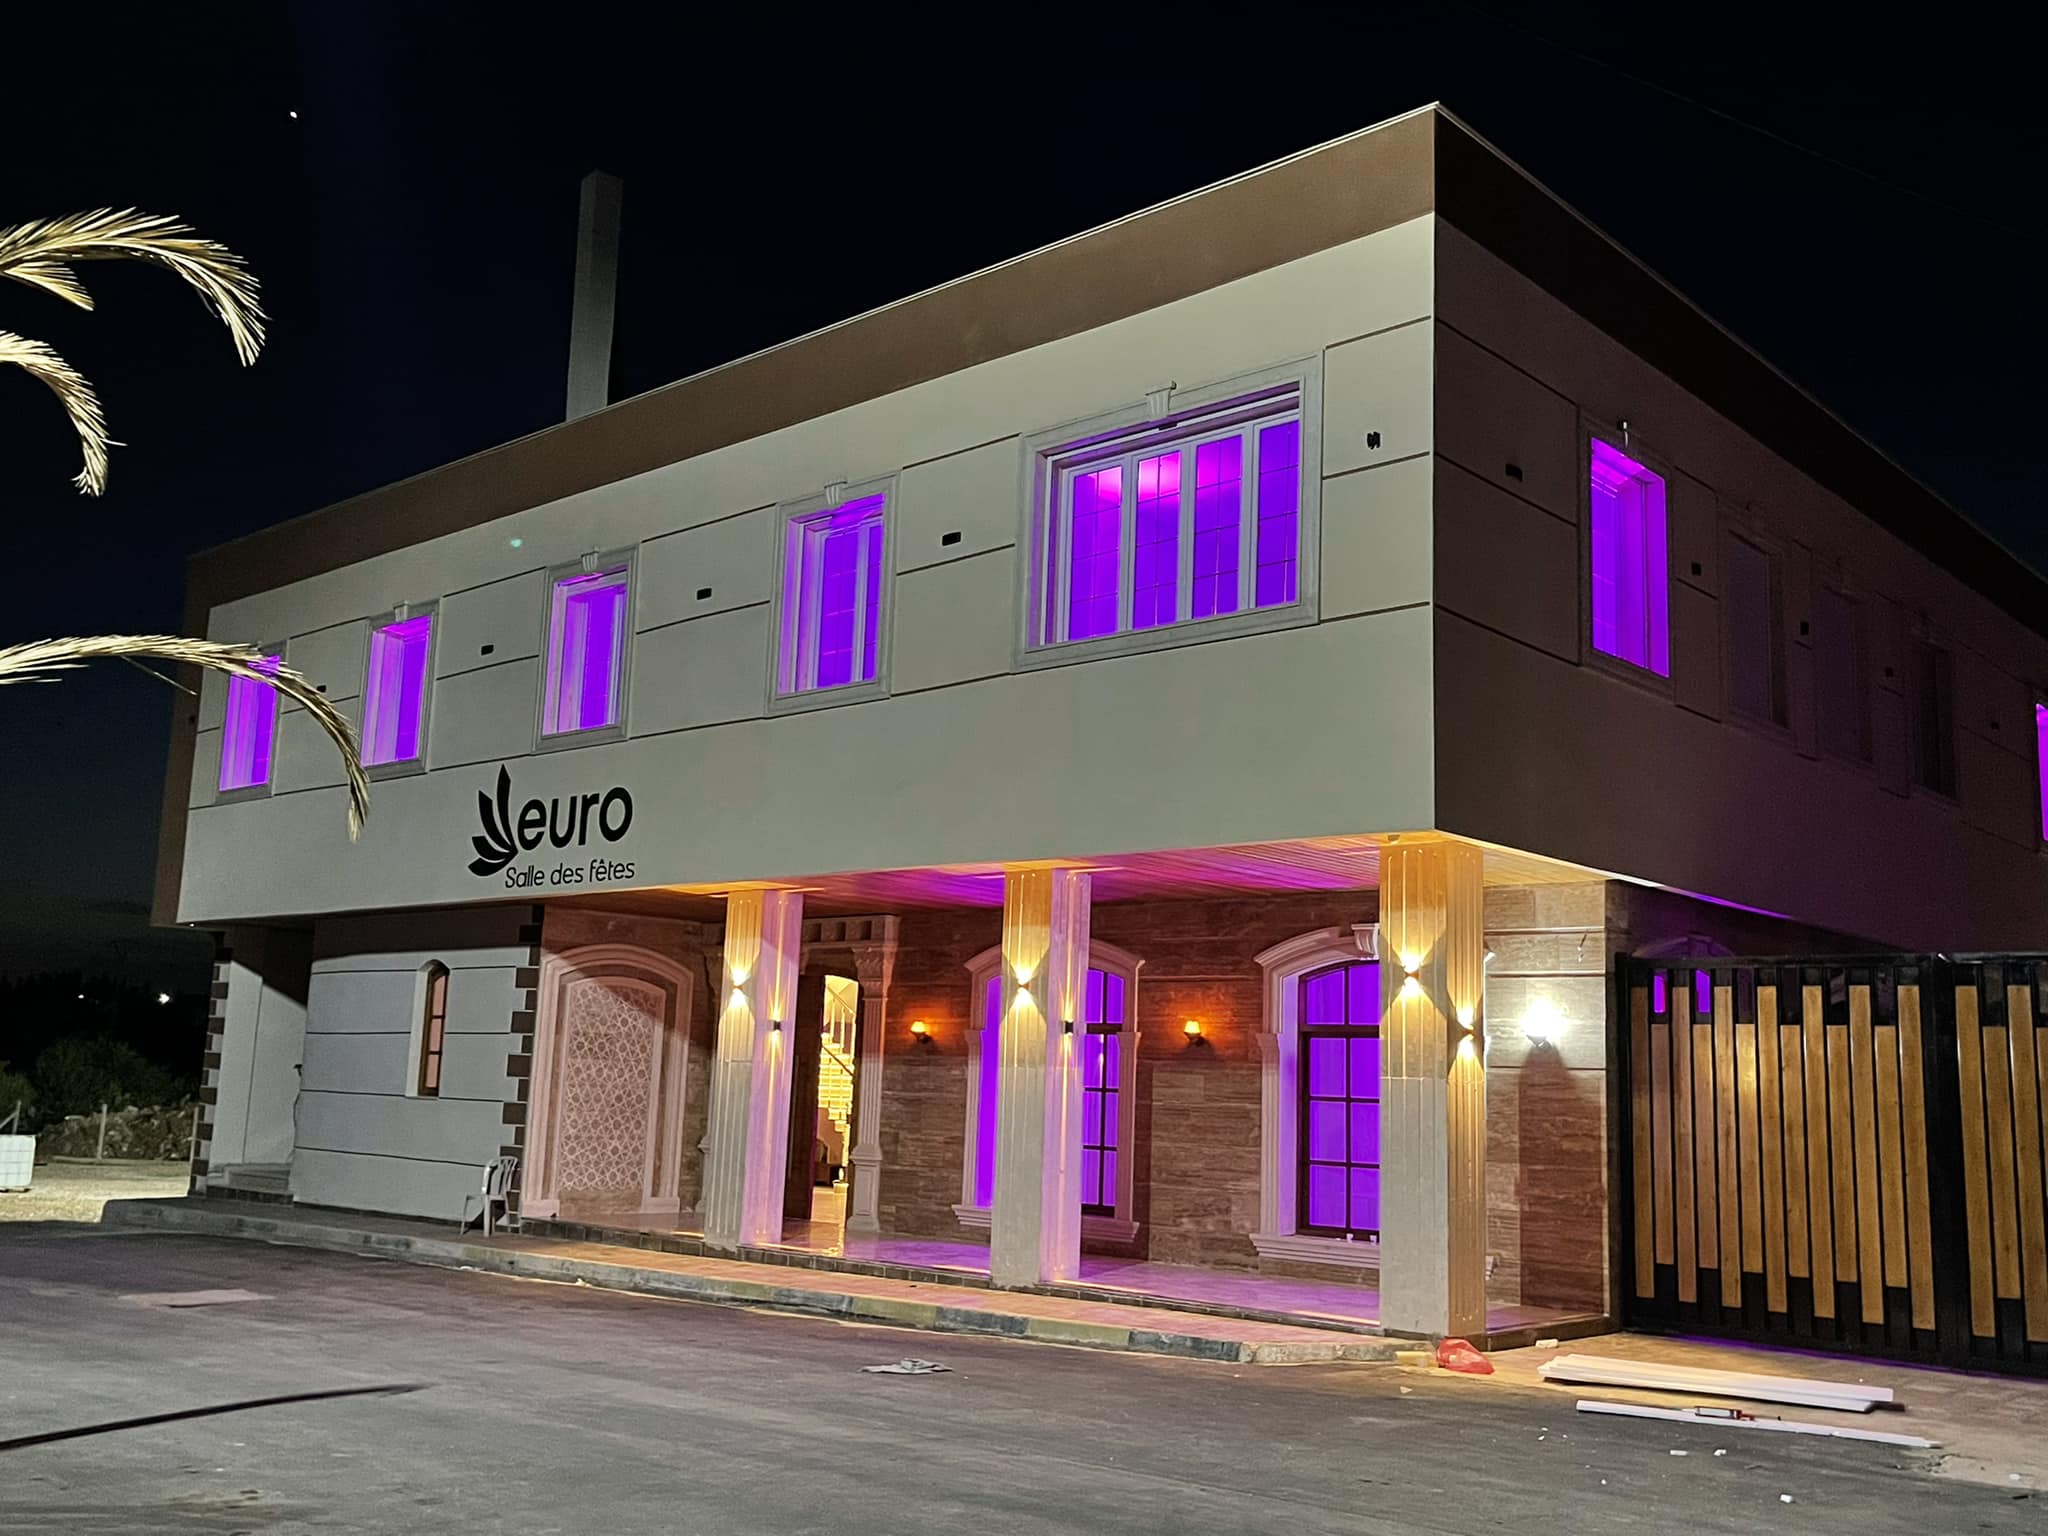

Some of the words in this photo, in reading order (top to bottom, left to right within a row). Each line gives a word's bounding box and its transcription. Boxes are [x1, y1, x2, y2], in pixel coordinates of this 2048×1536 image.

[505, 865, 545, 888] Salle
[550, 863, 584, 885] des
[589, 858, 635, 882] fêtes
